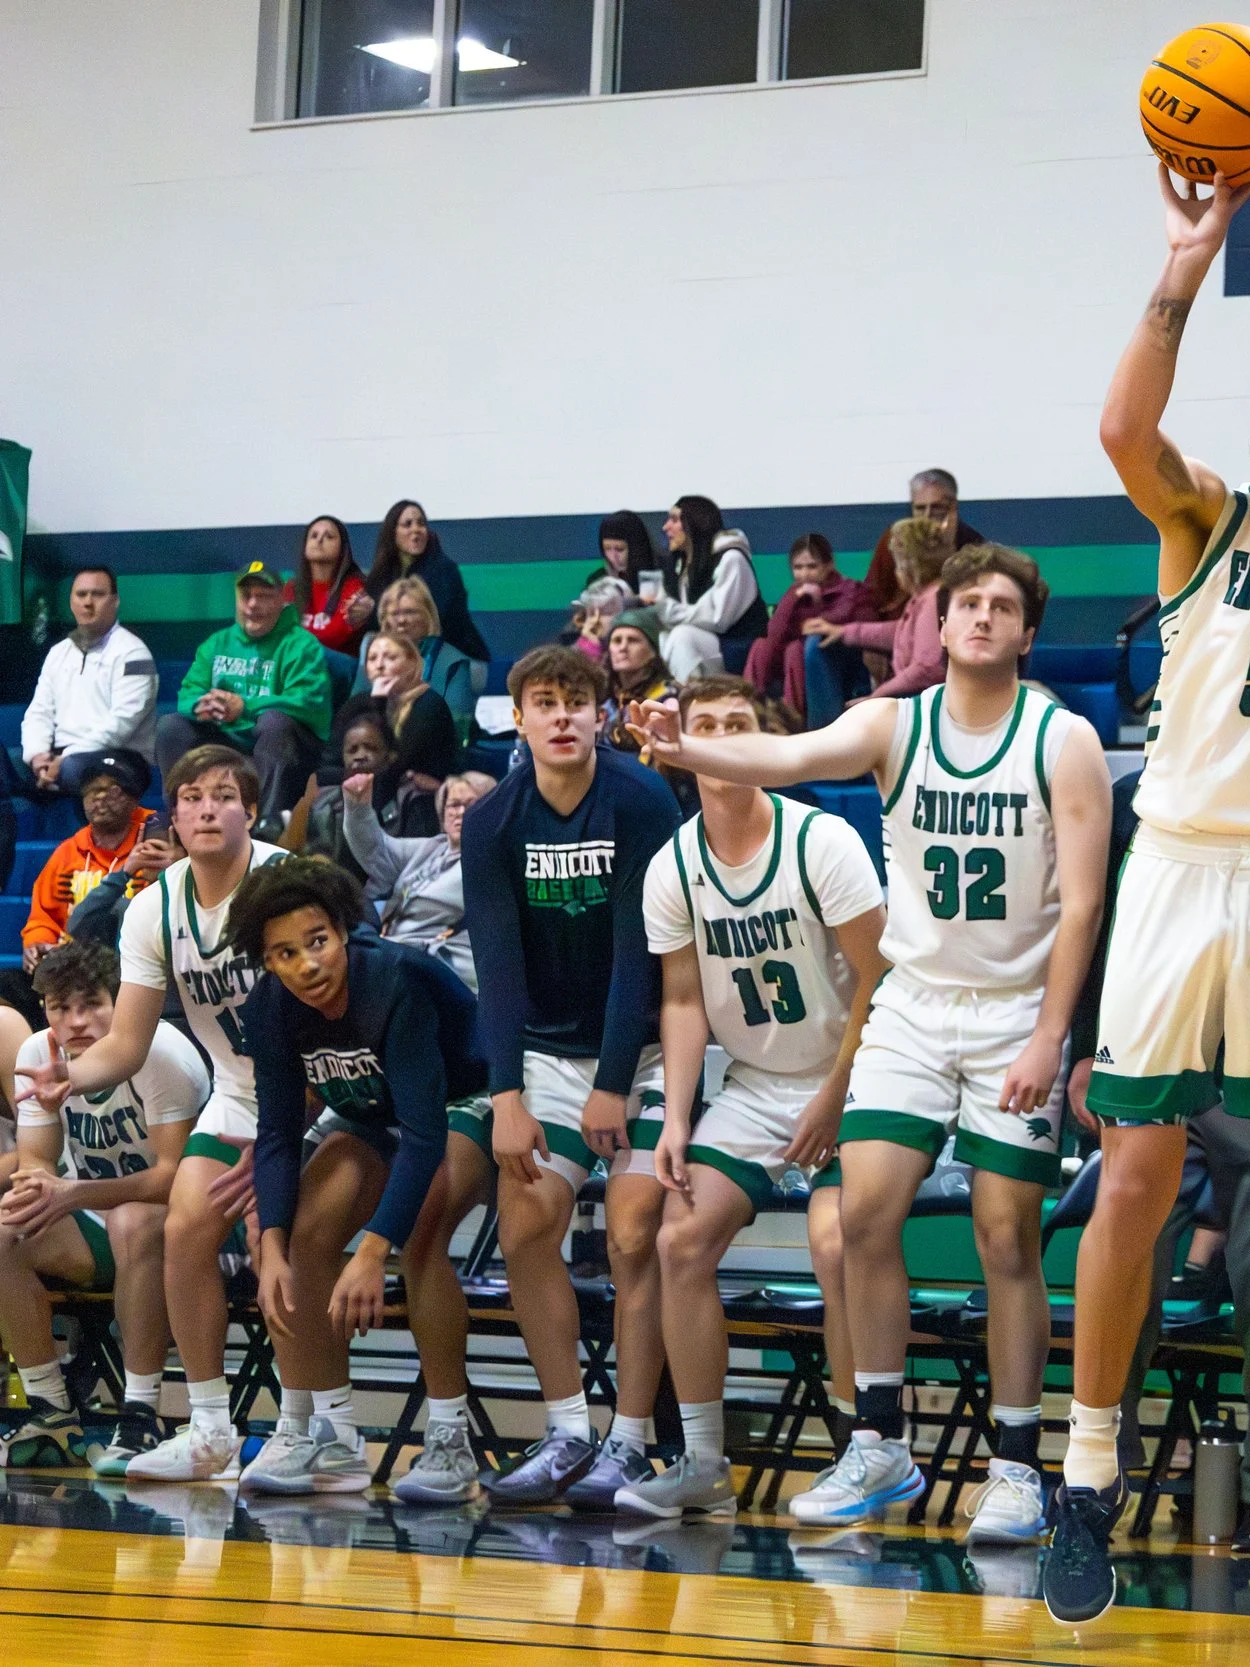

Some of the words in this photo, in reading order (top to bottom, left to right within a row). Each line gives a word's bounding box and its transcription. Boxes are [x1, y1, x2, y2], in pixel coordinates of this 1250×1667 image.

[912, 784, 1029, 837] ENDICOTT
[924, 845, 1007, 921] 32
[731, 959, 807, 1026] 13
